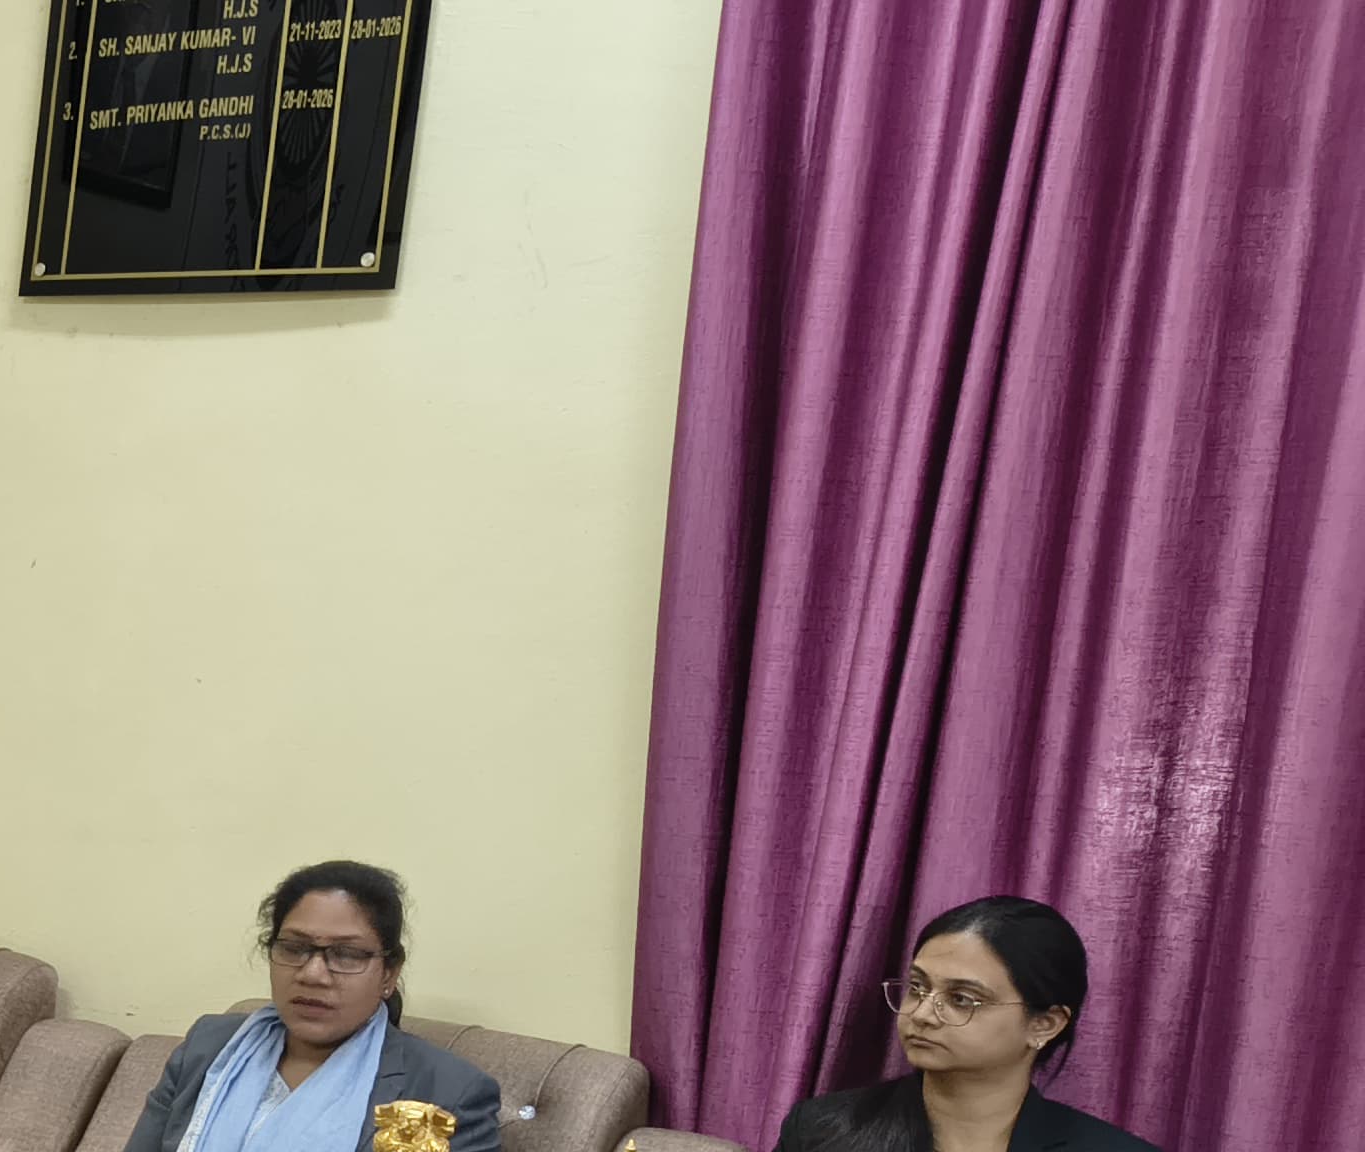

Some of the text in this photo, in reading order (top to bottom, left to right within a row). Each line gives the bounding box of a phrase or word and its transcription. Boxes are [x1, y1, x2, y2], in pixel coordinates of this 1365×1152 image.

[98, 38, 119, 57] SH.
[124, 32, 177, 55] SANJAY
[242, 26, 256, 46] VI
[289, 19, 342, 42] 21-11-2023
[216, 53, 253, 74] H.J.S
[63, 102, 74, 121] 3.
[89, 108, 121, 130] SMT.
[126, 100, 194, 126] PRIYANKA
[198, 95, 254, 118] GANDHI
